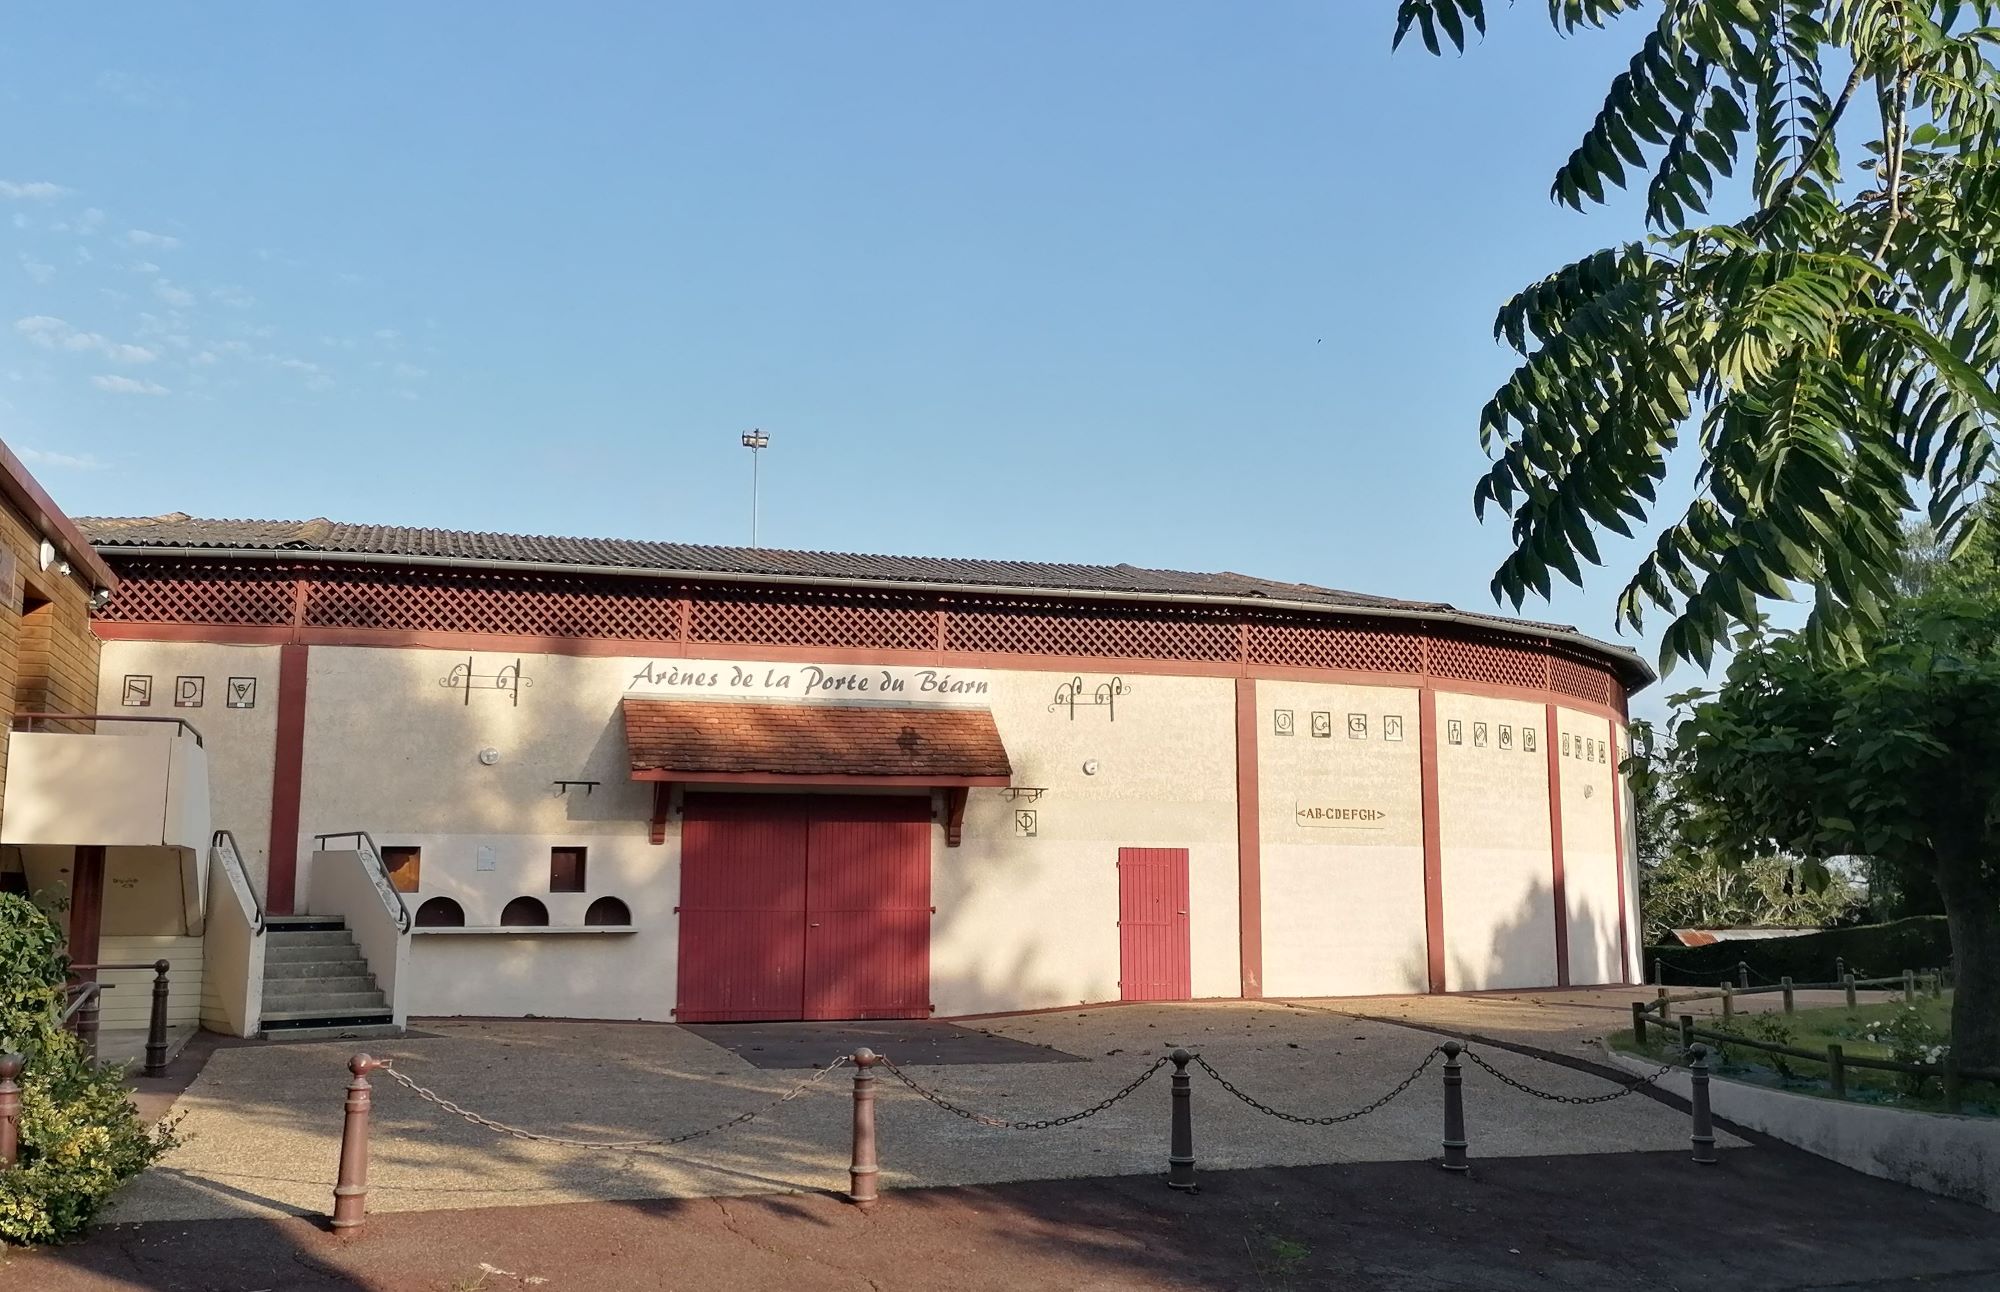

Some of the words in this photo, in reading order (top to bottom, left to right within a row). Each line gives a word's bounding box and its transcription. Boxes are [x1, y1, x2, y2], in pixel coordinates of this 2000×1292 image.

[628, 661, 719, 690] Arènes
[730, 665, 754, 688] de
[764, 668, 791, 689] la
[800, 665, 869, 696] Porte
[879, 670, 905, 692] du
[914, 670, 988, 694] Béarn
